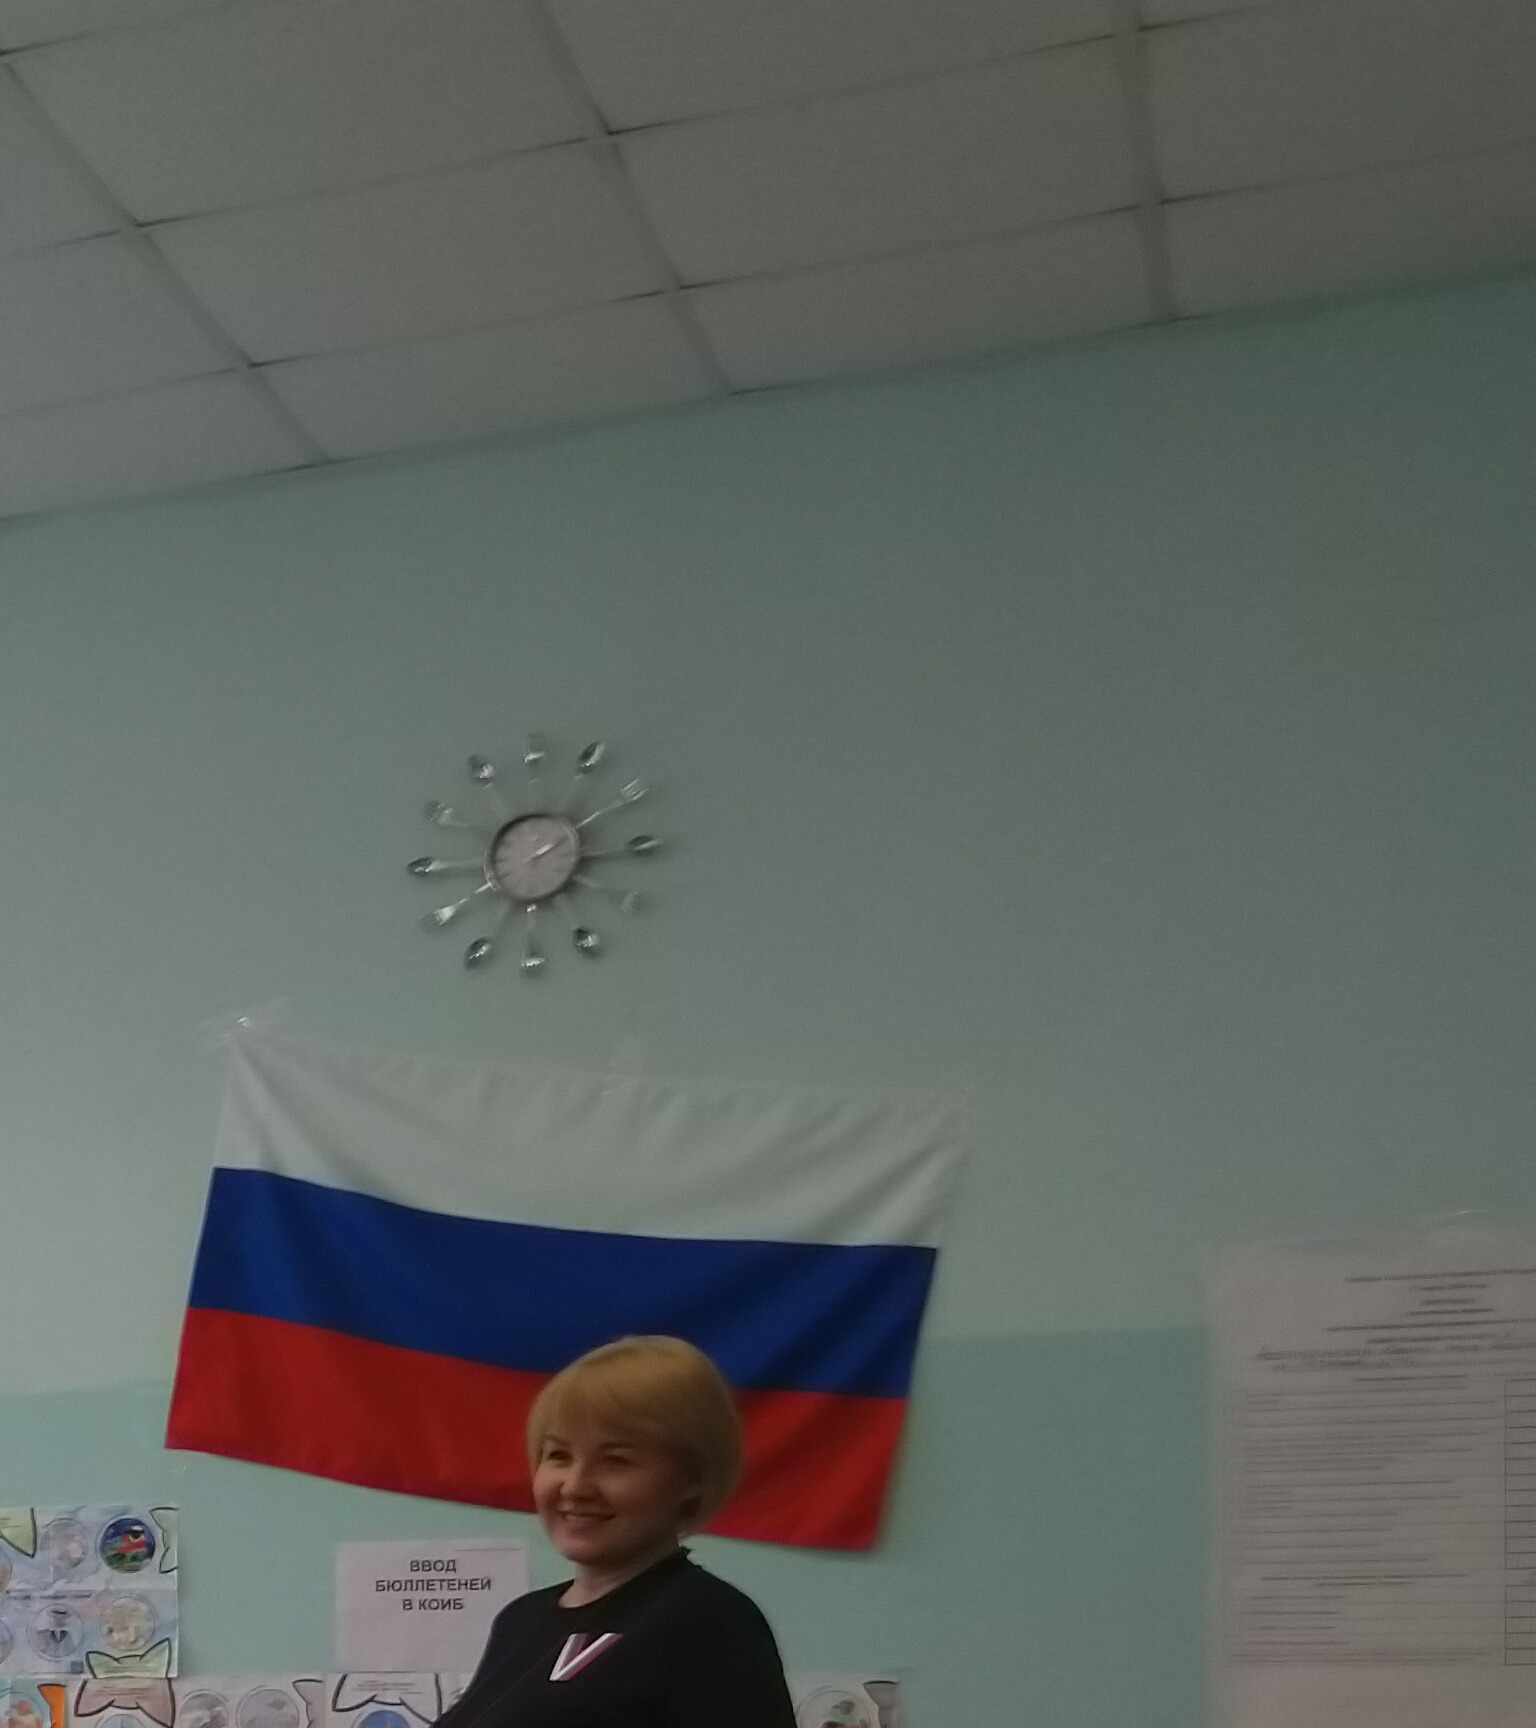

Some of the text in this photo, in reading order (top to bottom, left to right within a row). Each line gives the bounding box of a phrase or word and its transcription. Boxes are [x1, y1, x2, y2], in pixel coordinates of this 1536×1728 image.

[410, 1559, 458, 1573] ВВОД
[375, 1577, 492, 1592] БЮЛЛЕТЕНЕЙ
[402, 1597, 464, 1611] В КОИБ
